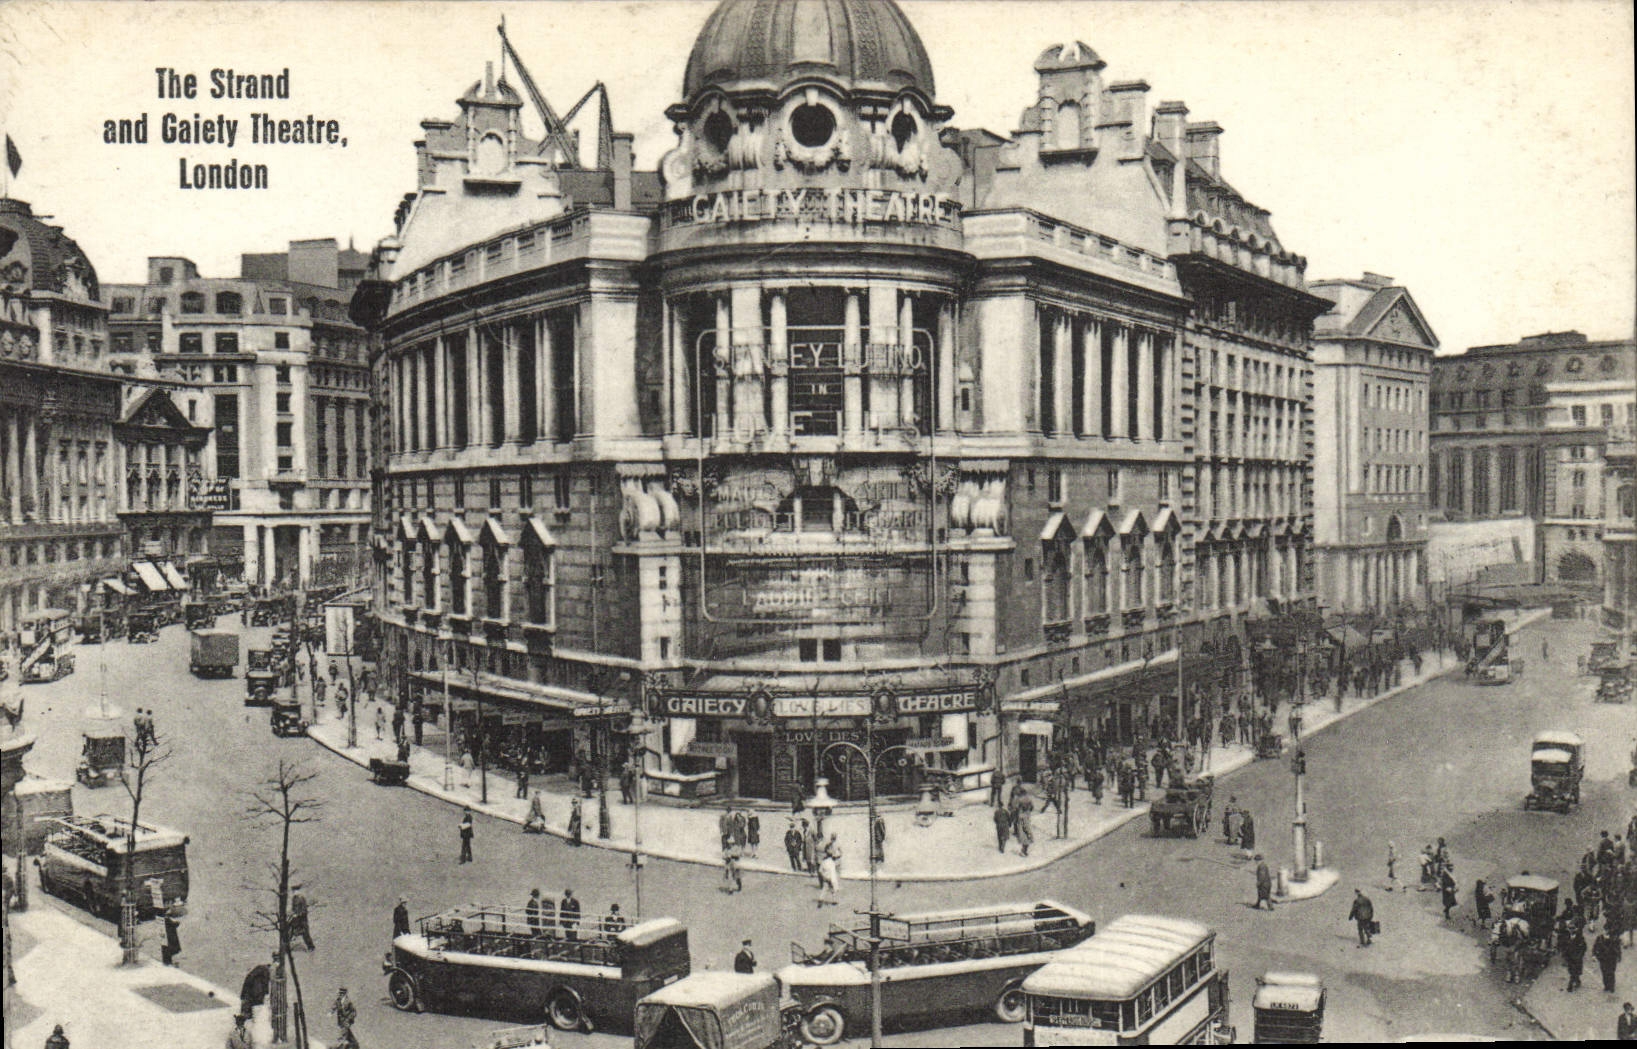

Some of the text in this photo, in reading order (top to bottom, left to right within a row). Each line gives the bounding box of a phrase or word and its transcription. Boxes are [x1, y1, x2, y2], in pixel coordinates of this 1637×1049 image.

[692, 188, 951, 225] GAIETY THEATRE
[667, 697, 747, 714] GAIETY
[898, 692, 976, 711] THEATRE
